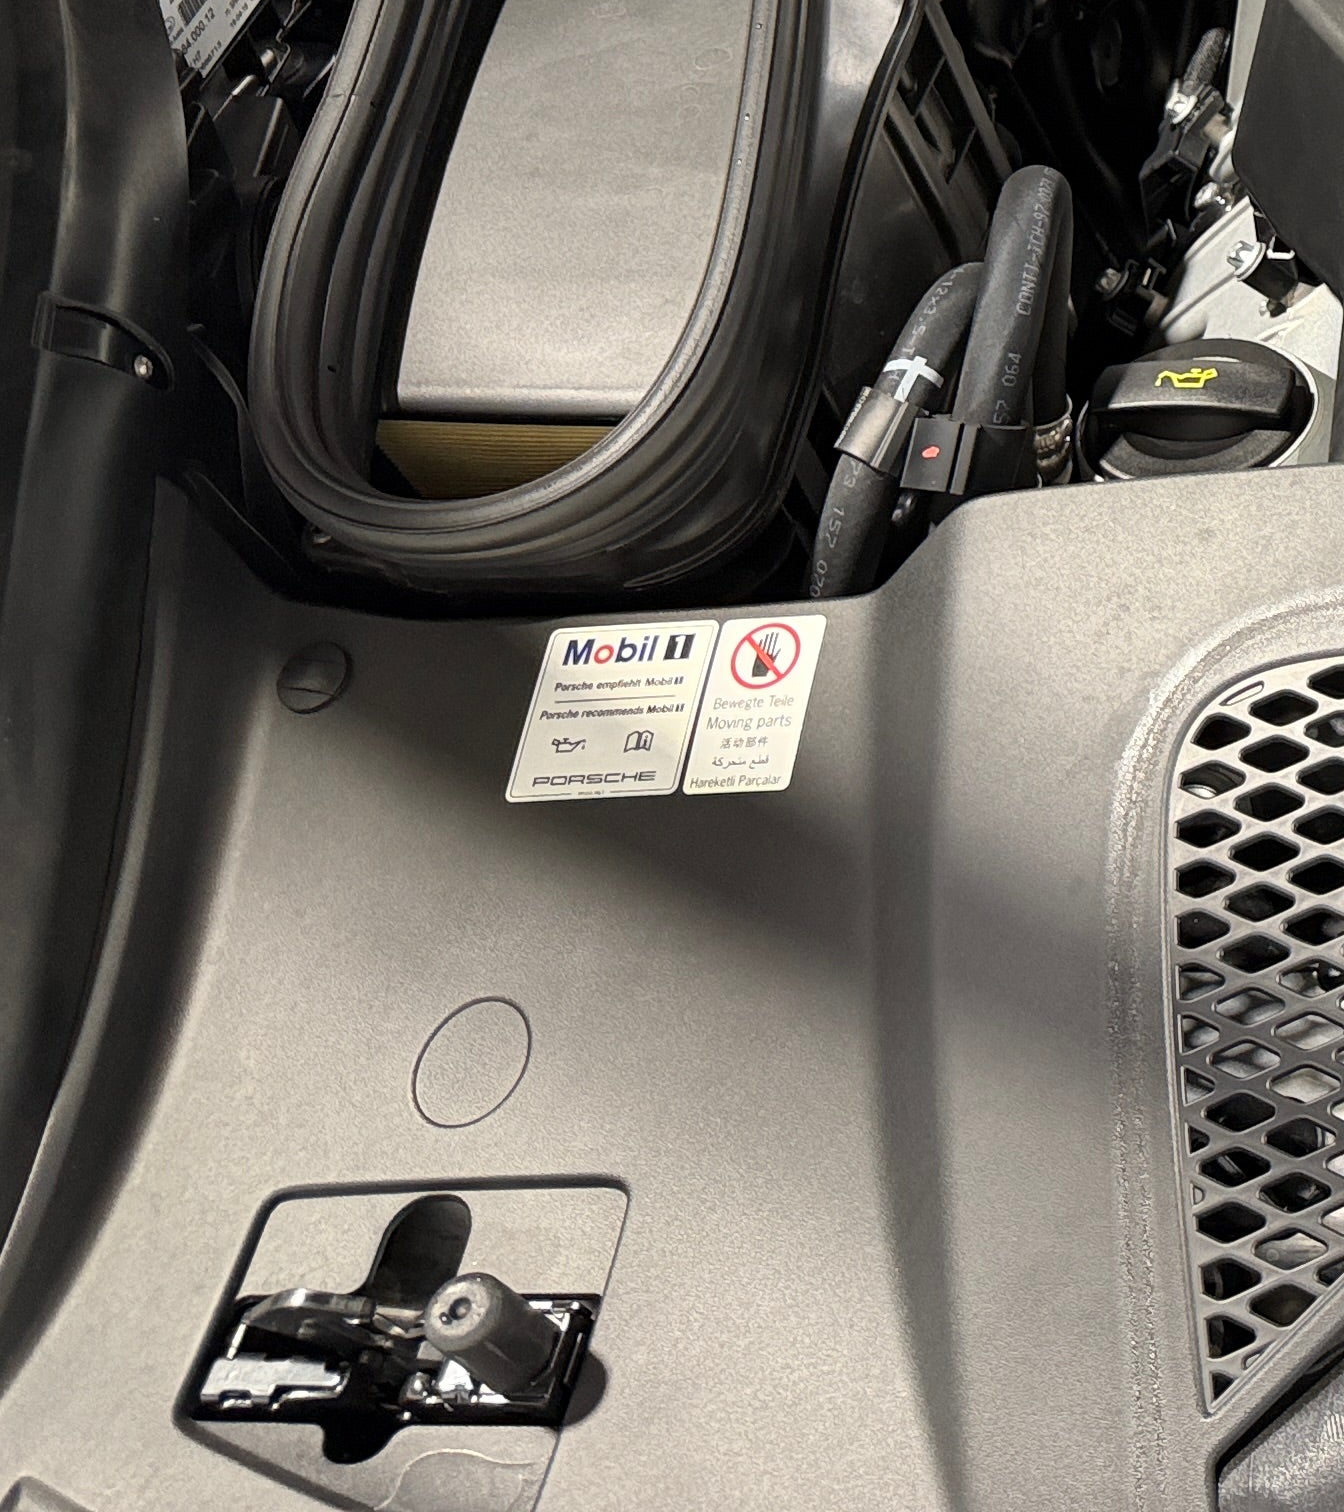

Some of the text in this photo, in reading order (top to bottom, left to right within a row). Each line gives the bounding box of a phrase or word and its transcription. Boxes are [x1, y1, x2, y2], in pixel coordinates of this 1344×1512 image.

[562, 635, 660, 666] Mobil
[554, 680, 594, 693] Porsche
[596, 678, 641, 691] empfiehlt
[713, 695, 794, 710] Bewegte Teile
[539, 708, 579, 721] Porsche
[581, 706, 644, 718] recommends
[706, 714, 792, 731] Moving parts
[532, 771, 657, 787] PORSCHE
[690, 774, 782, 789] Hareketli Parçalar
